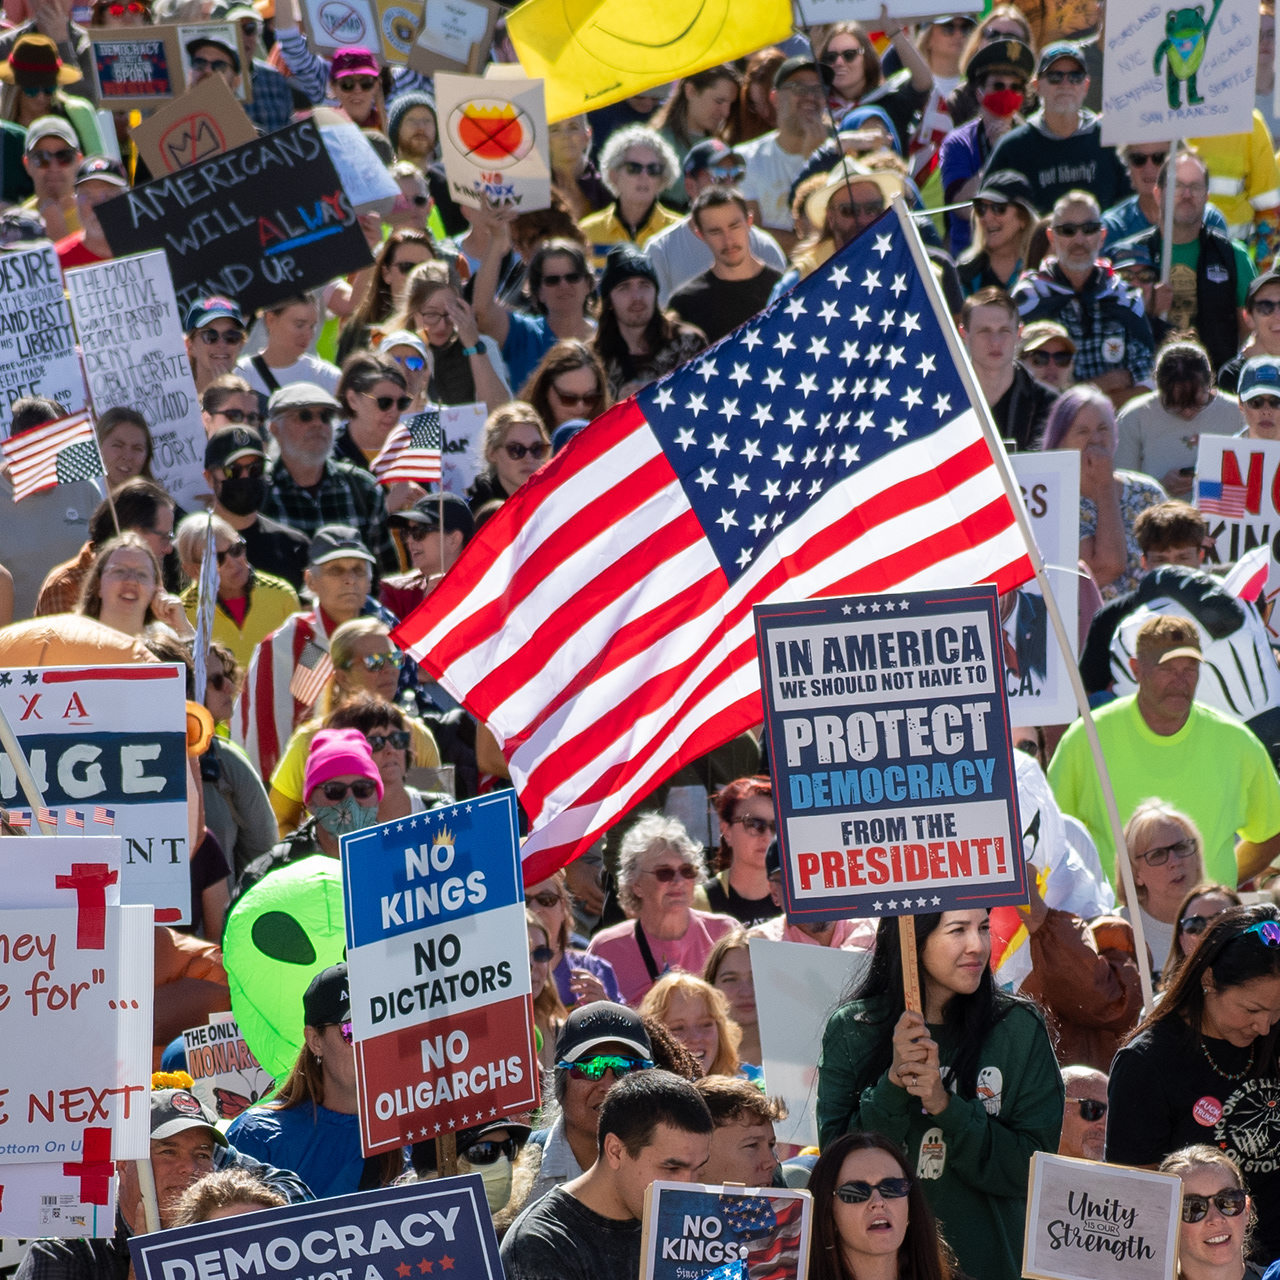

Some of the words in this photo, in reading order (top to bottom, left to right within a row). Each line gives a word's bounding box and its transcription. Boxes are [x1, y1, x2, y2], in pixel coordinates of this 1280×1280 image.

[1218, 12, 1243, 36] LA
[126, 123, 320, 229] AMERICANS
[166, 202, 255, 256] WILL
[258, 190, 357, 246] ALWAYS
[103, 258, 146, 285] MOST
[260, 254, 304, 284] UP.
[31, 301, 65, 328] FAST
[76, 279, 157, 318] EFFECTIVE
[17, 324, 71, 359] LIBERTY
[776, 638, 815, 680] IN
[822, 624, 986, 675] AMERICA
[779, 680, 809, 701] WE
[811, 674, 877, 695] SHOULD
[882, 671, 915, 690] NOT
[920, 668, 962, 687] HAVE
[965, 665, 987, 683] TO
[783, 701, 992, 767] PROTECT
[788, 758, 997, 810] DEMOCRACY
[841, 816, 907, 846] FROM
[912, 813, 957, 839] THE
[404, 844, 455, 882] NO
[798, 836, 1007, 891] PRESIDENT!
[380, 870, 487, 930] KINGS
[413, 934, 461, 976] NO
[370, 960, 513, 1025] DICTATORS
[184, 1029, 207, 1047] THE
[208, 1022, 239, 1041] ONLY
[421, 1030, 469, 1073] NO
[27, 1085, 145, 1123] NEXT
[375, 1056, 523, 1121] OLIGARCHS
[1194, 1107, 1217, 1124] TRUMP
[44, 1142, 66, 1154] On
[683, 1215, 722, 1239] NO
[1068, 1191, 1139, 1229] Unity
[1097, 1224, 1116, 1233] OUR
[662, 1238, 739, 1265] KINGS
[1047, 1220, 1156, 1261] Strength
[676, 1267, 699, 1280] Since
